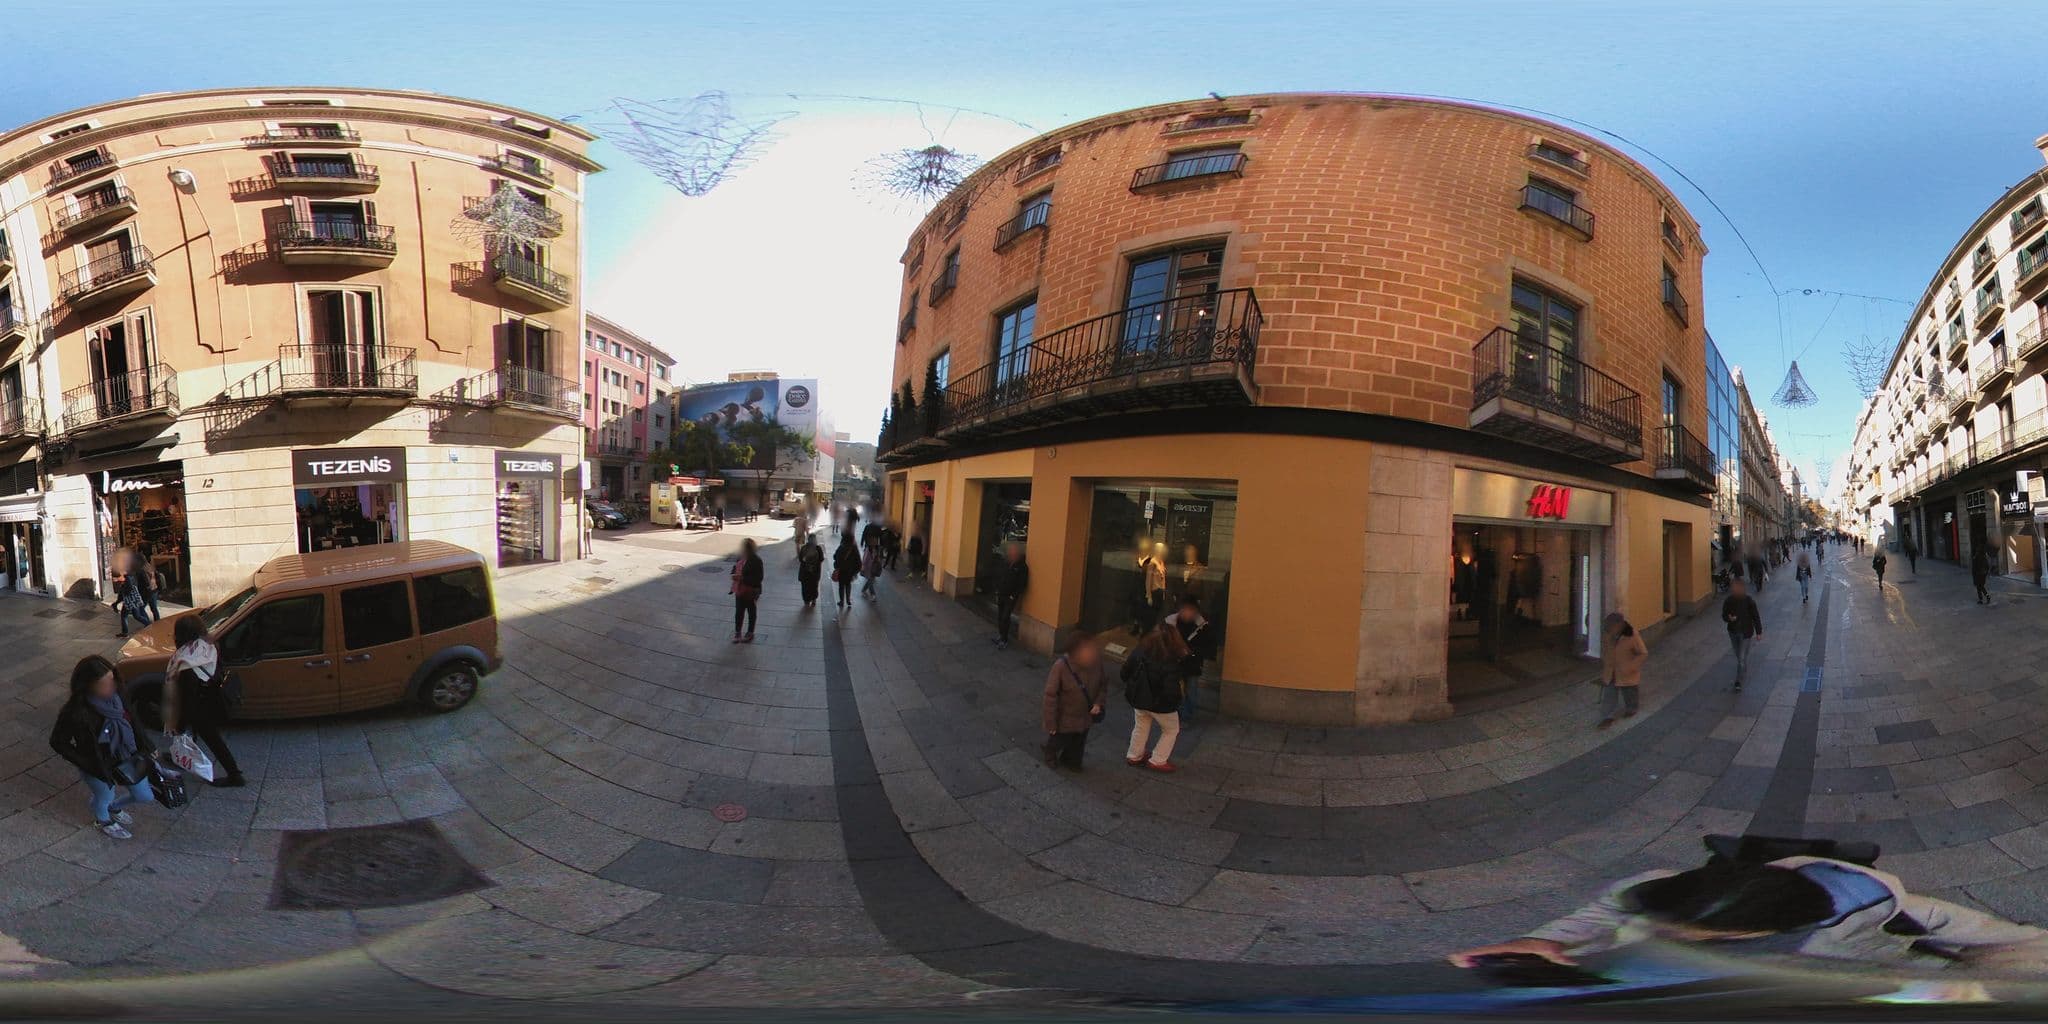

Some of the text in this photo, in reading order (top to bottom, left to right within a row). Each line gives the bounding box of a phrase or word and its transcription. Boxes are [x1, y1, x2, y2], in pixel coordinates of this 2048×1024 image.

[308, 456, 391, 475] TEZENIS
[503, 459, 554, 472] TEZENIS
[202, 478, 214, 488] 12
[1527, 484, 1572, 519] H&M
